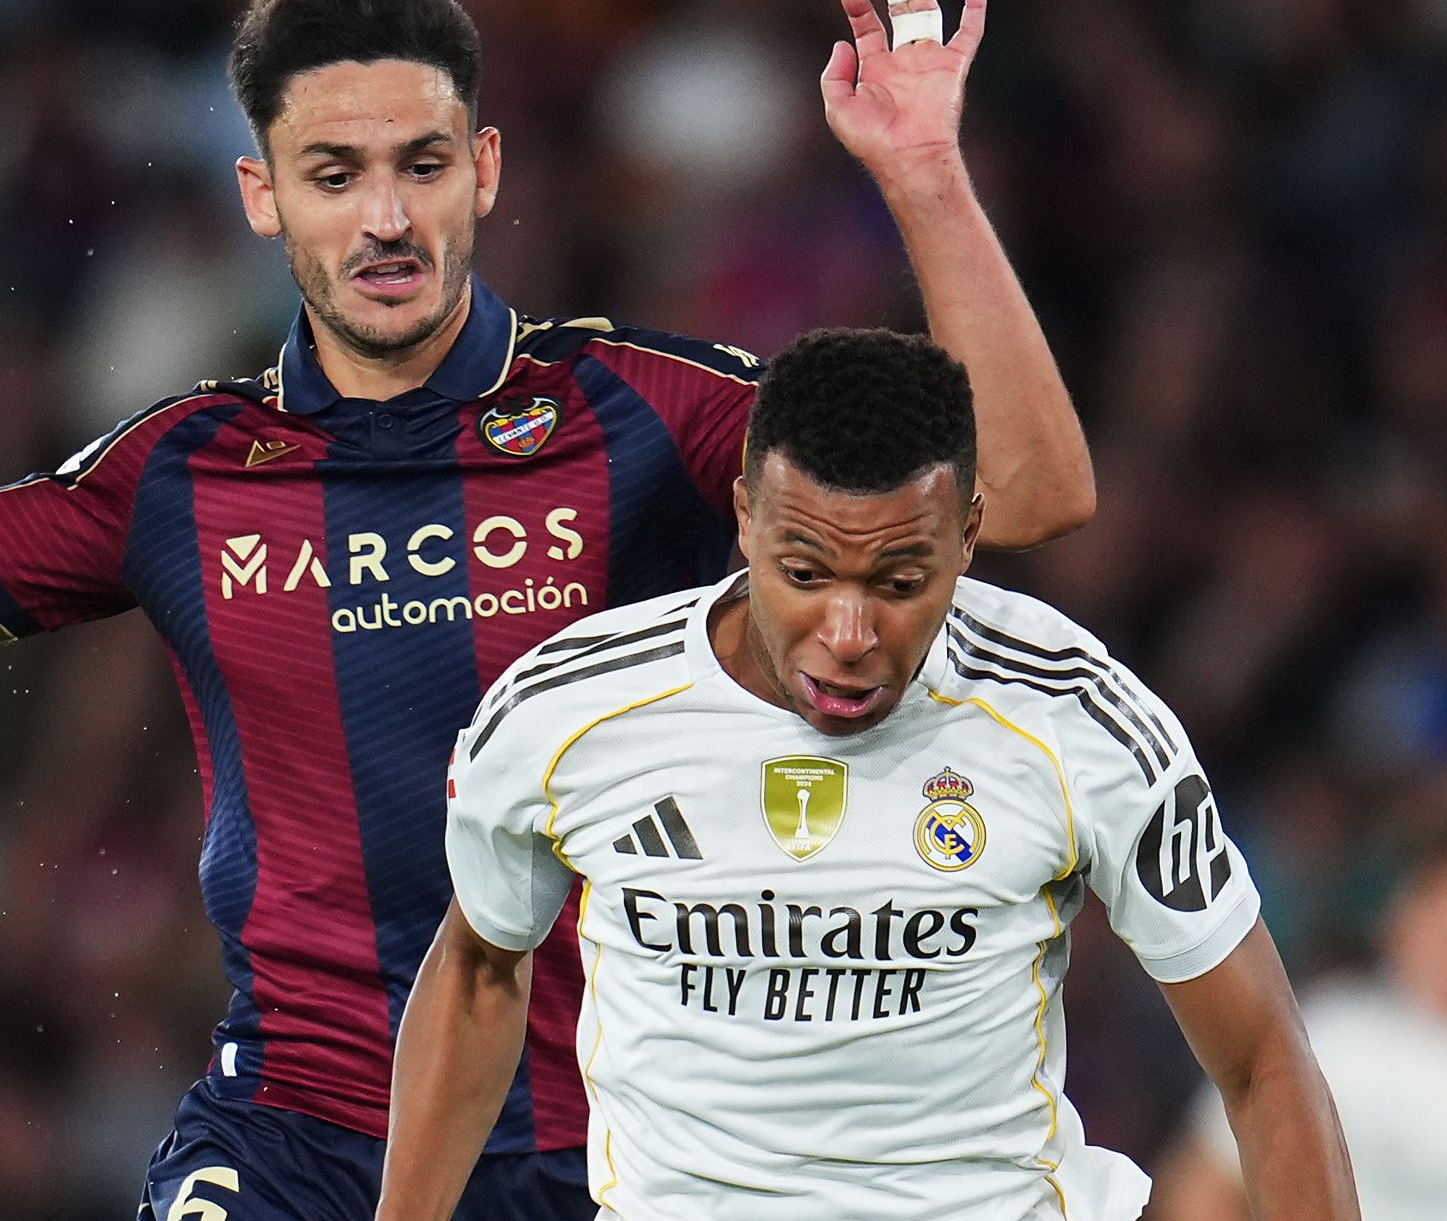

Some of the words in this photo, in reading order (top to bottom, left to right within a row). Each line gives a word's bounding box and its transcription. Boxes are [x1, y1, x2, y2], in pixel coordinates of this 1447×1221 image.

[220, 507, 584, 600] MARCOS
[331, 576, 589, 633] automoción
[773, 767, 836, 776] INTERCONTINENTAL
[1158, 785, 1227, 909] hp
[620, 886, 980, 962] Emirates
[680, 962, 745, 1016] FLY
[762, 966, 927, 1023] BETTER
